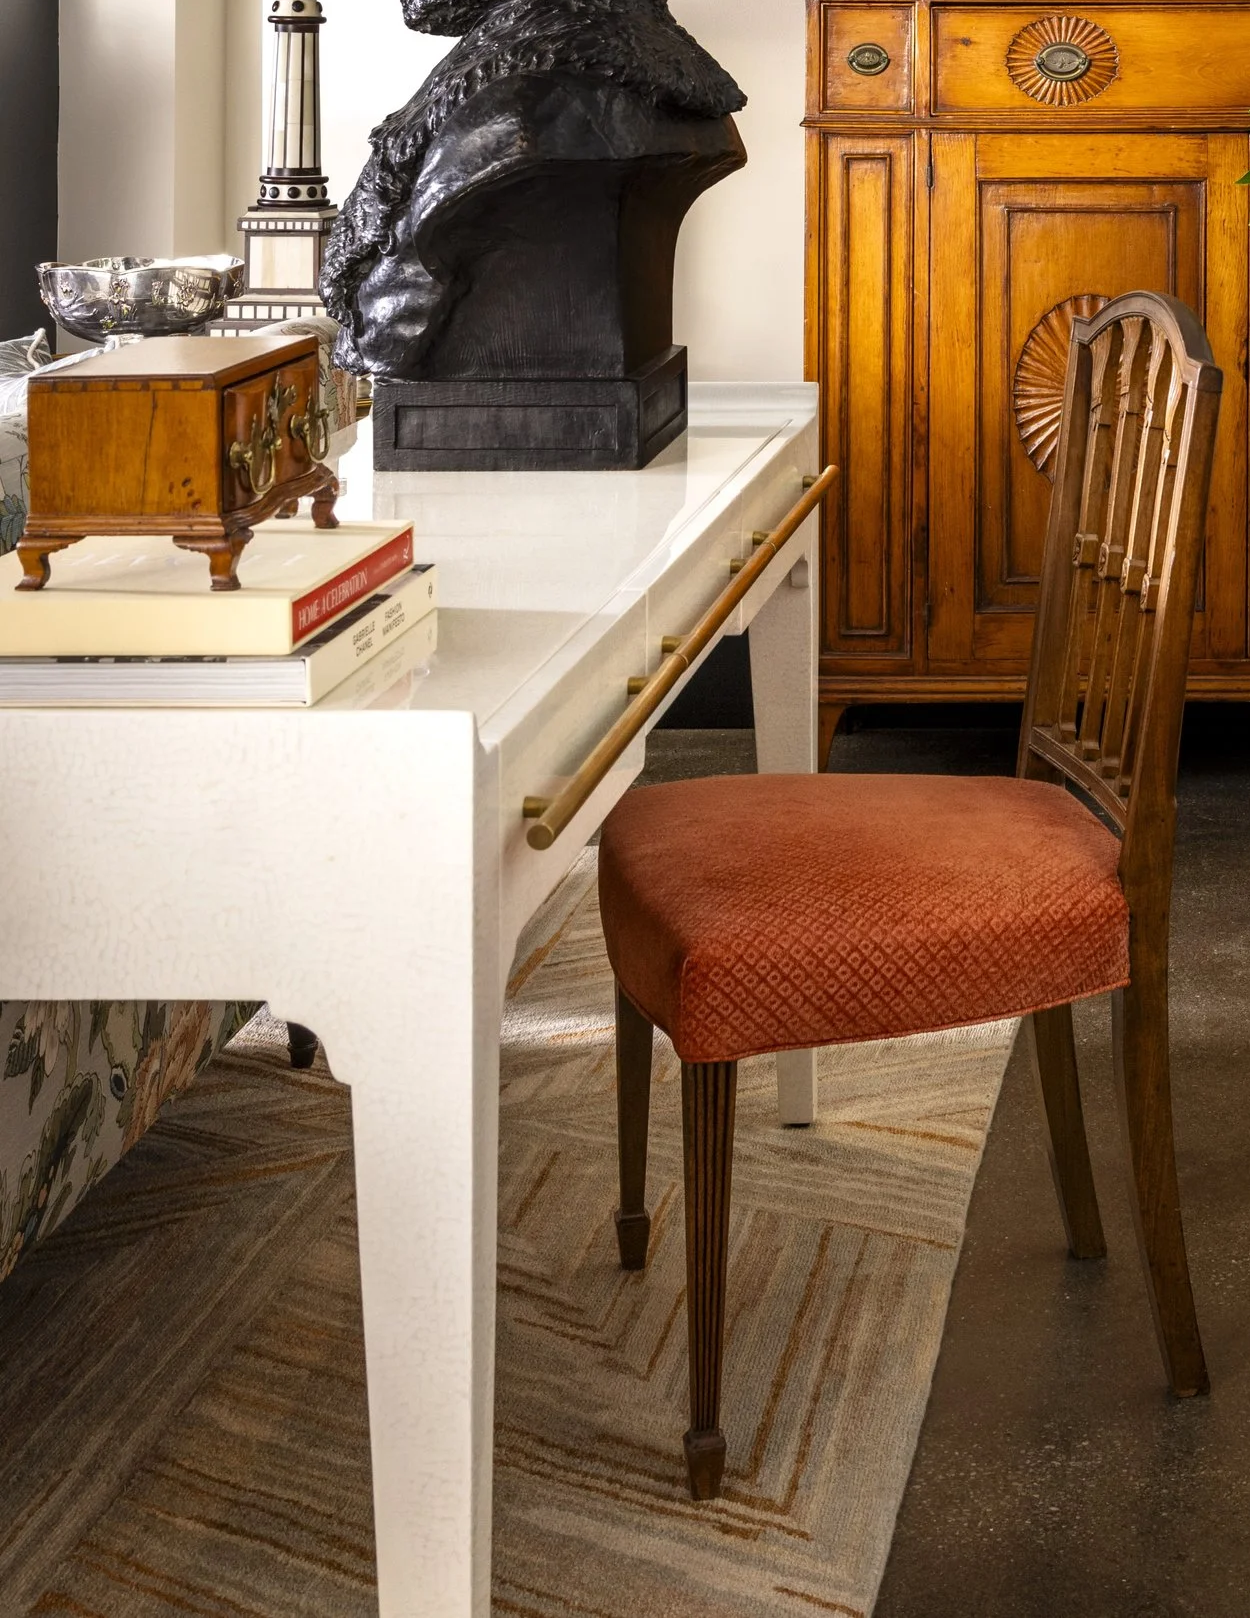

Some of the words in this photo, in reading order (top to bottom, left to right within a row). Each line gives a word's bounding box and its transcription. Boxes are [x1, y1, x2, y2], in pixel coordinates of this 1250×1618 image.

[326, 568, 368, 611] CELEBRATION
[384, 601, 402, 622] FASHION
[352, 621, 376, 646] GABRIELLE
[382, 613, 405, 637] MANIFESTO
[356, 638, 373, 657] CHANEL
